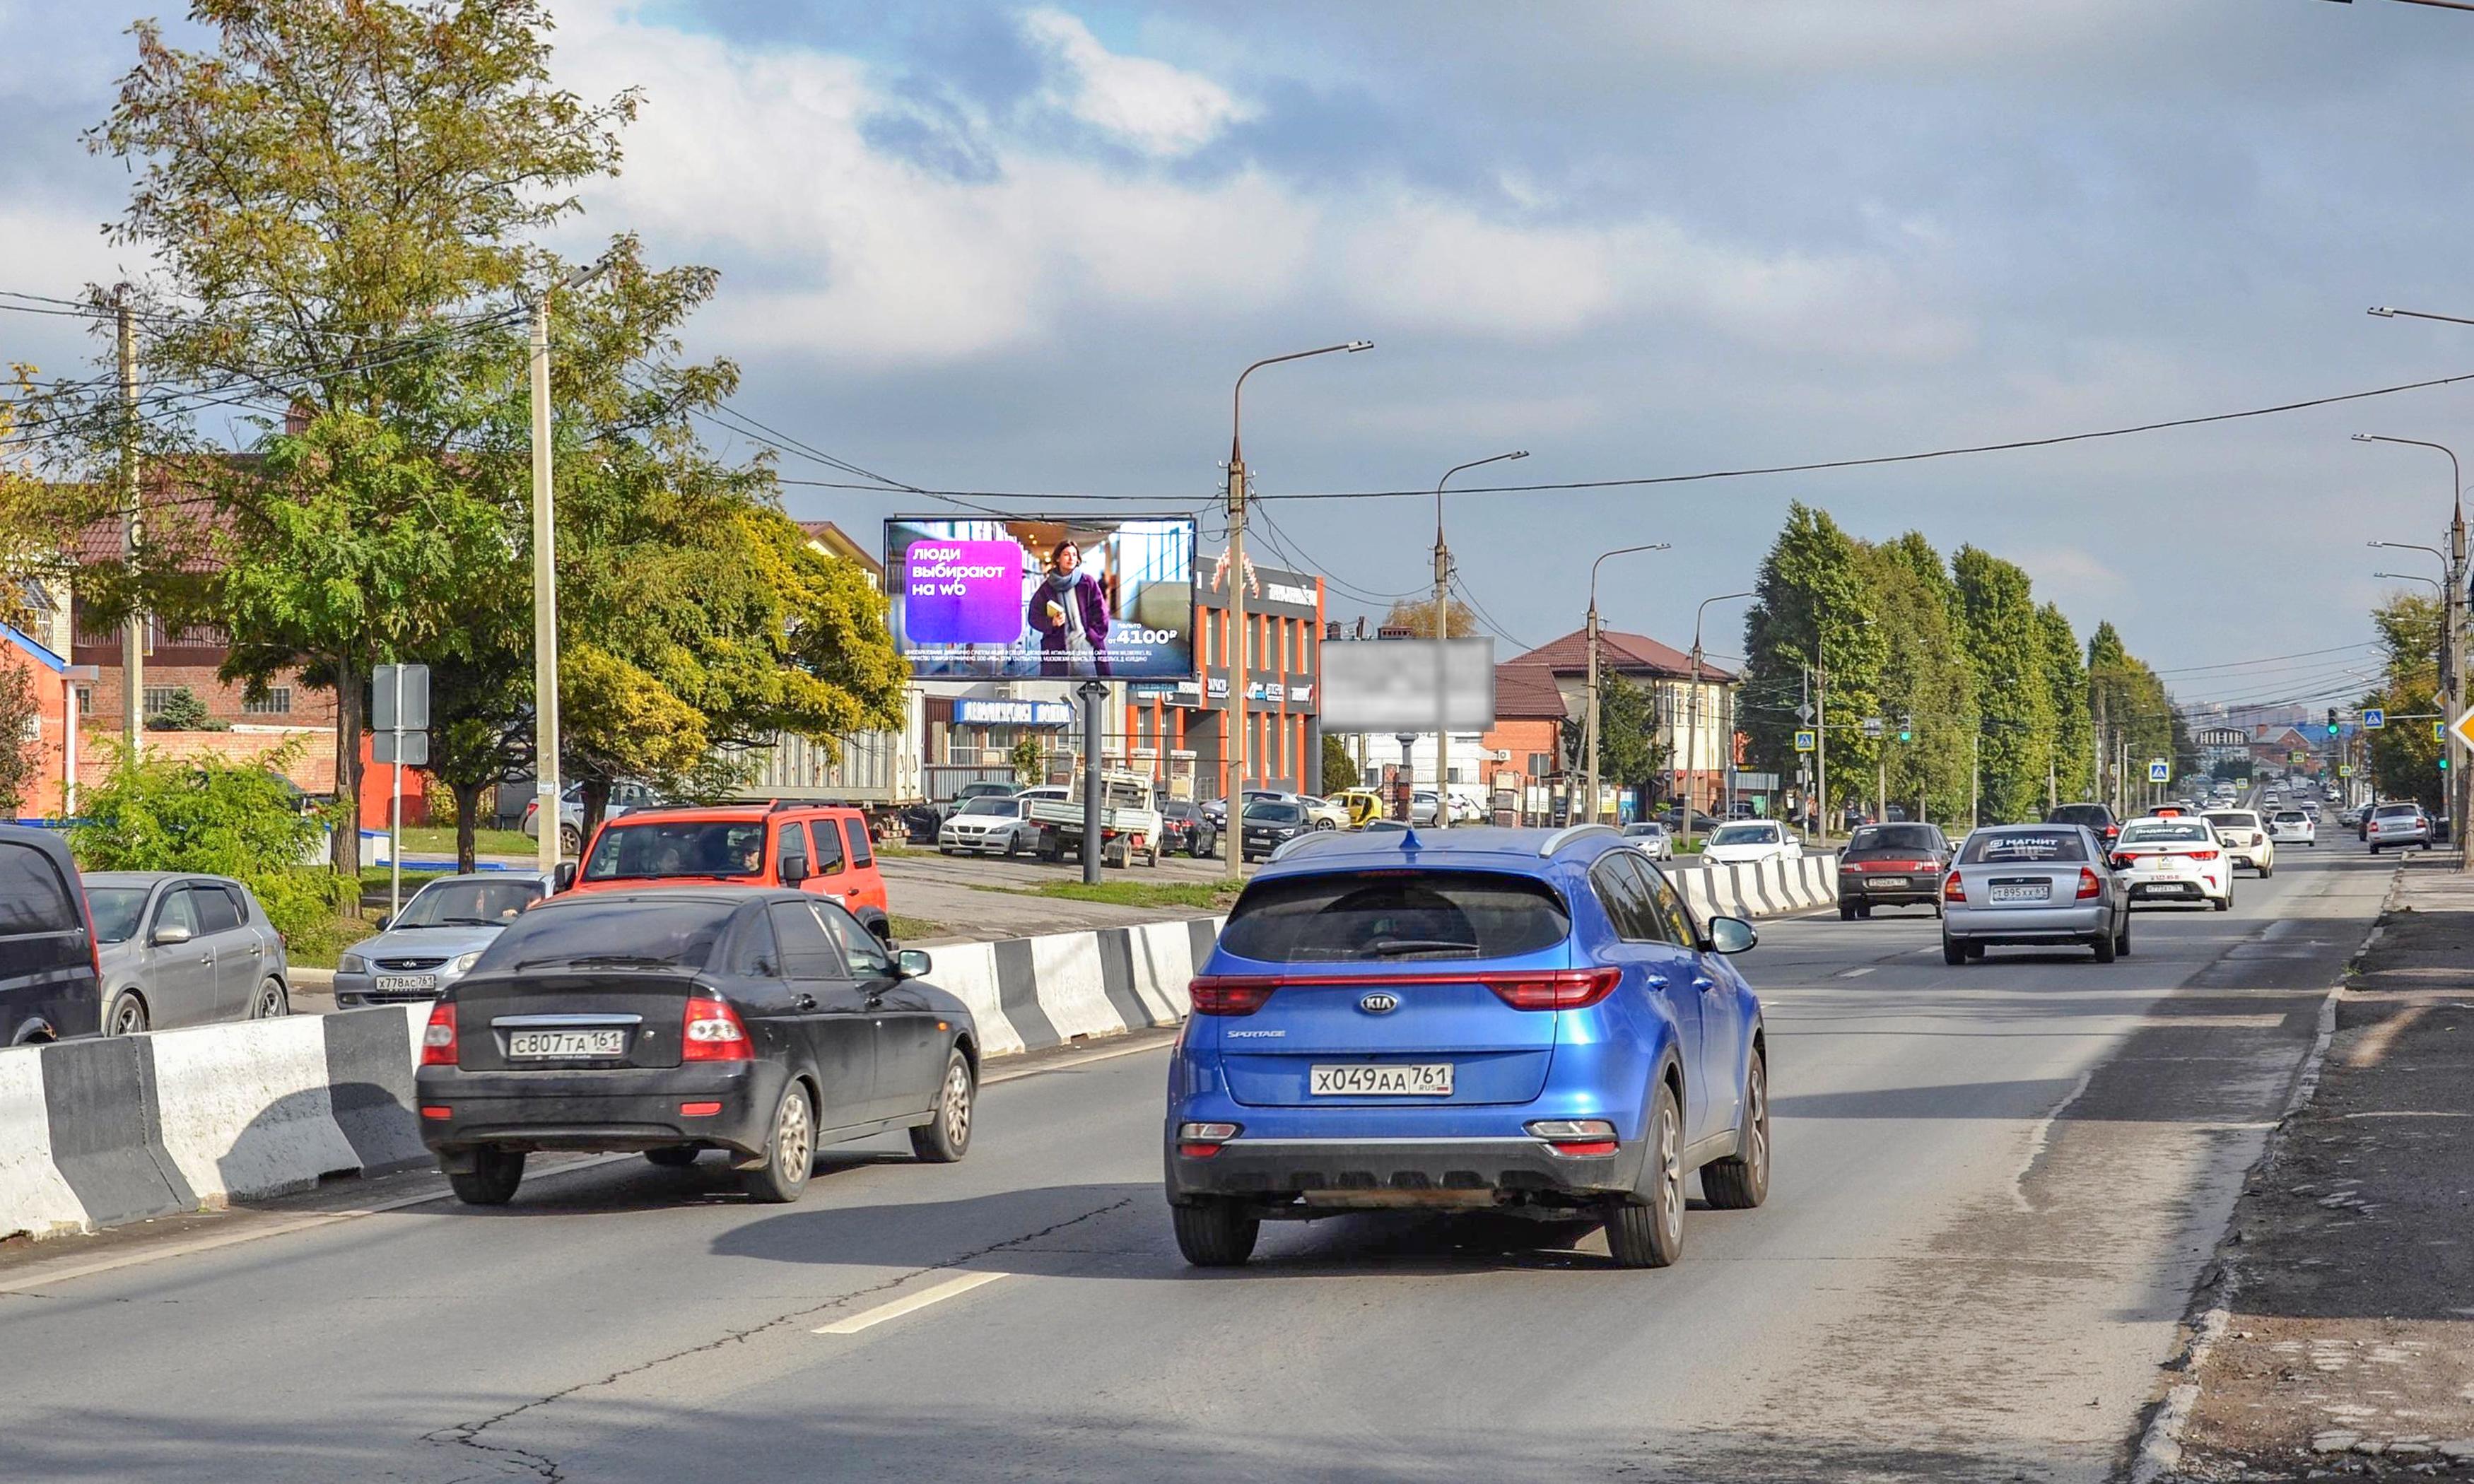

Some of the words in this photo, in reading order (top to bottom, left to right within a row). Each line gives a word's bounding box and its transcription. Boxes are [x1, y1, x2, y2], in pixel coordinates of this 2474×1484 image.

[913, 548, 961, 563] люди
[912, 562, 1006, 582] выбирают
[912, 584, 935, 596] на
[939, 579, 967, 596] wb
[1366, 997, 1392, 1009] KIA
[1227, 1030, 1286, 1039] SPORTAGE
